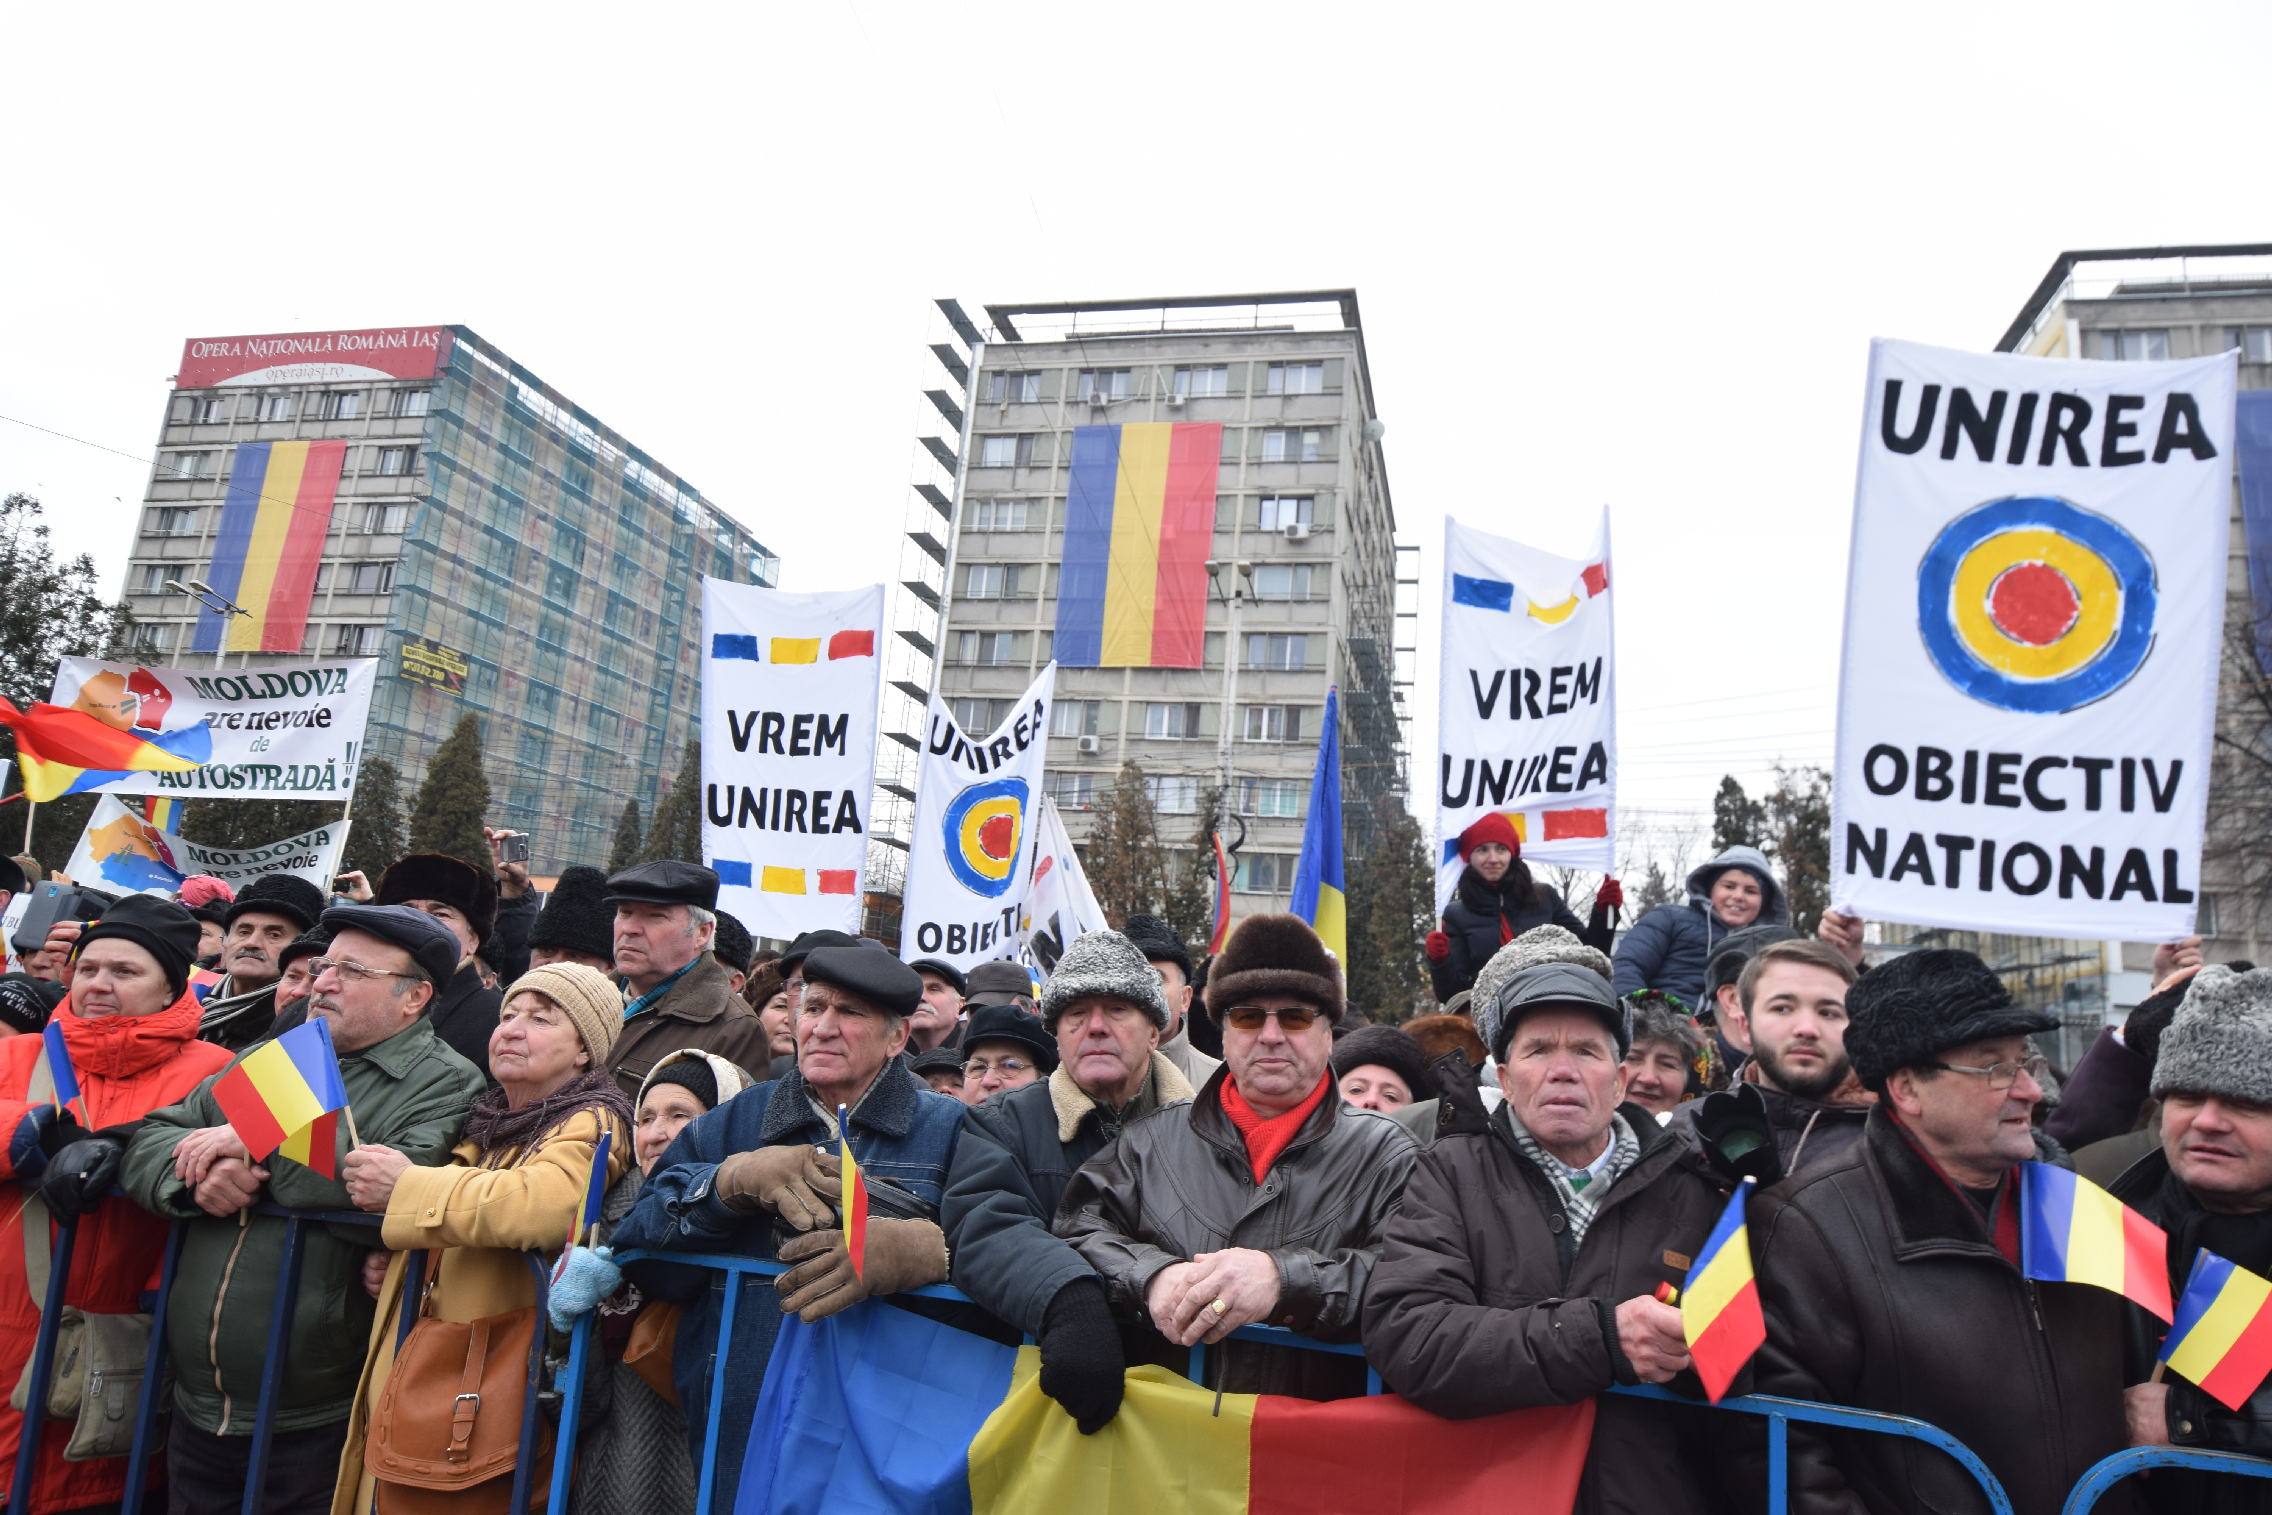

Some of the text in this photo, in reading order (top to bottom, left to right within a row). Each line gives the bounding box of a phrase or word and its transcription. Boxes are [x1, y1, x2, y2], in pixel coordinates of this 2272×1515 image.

[192, 341, 241, 357] OPERA
[1881, 379, 2217, 468] UNIREA
[184, 667, 348, 701] MOLDOVA
[1469, 656, 1602, 720] VREM
[203, 703, 332, 730] are nevoie
[727, 710, 849, 757] VREM
[929, 699, 1044, 774] UNIREA
[250, 736, 270, 752] de
[1442, 741, 1608, 808] UNIREA
[1863, 743, 2183, 813] OBIECTIV
[707, 783, 862, 834] UNIREA
[186, 830, 330, 866] MOLDOVA
[243, 851, 318, 876] nevoie
[1845, 822, 2195, 904] NATIONAL
